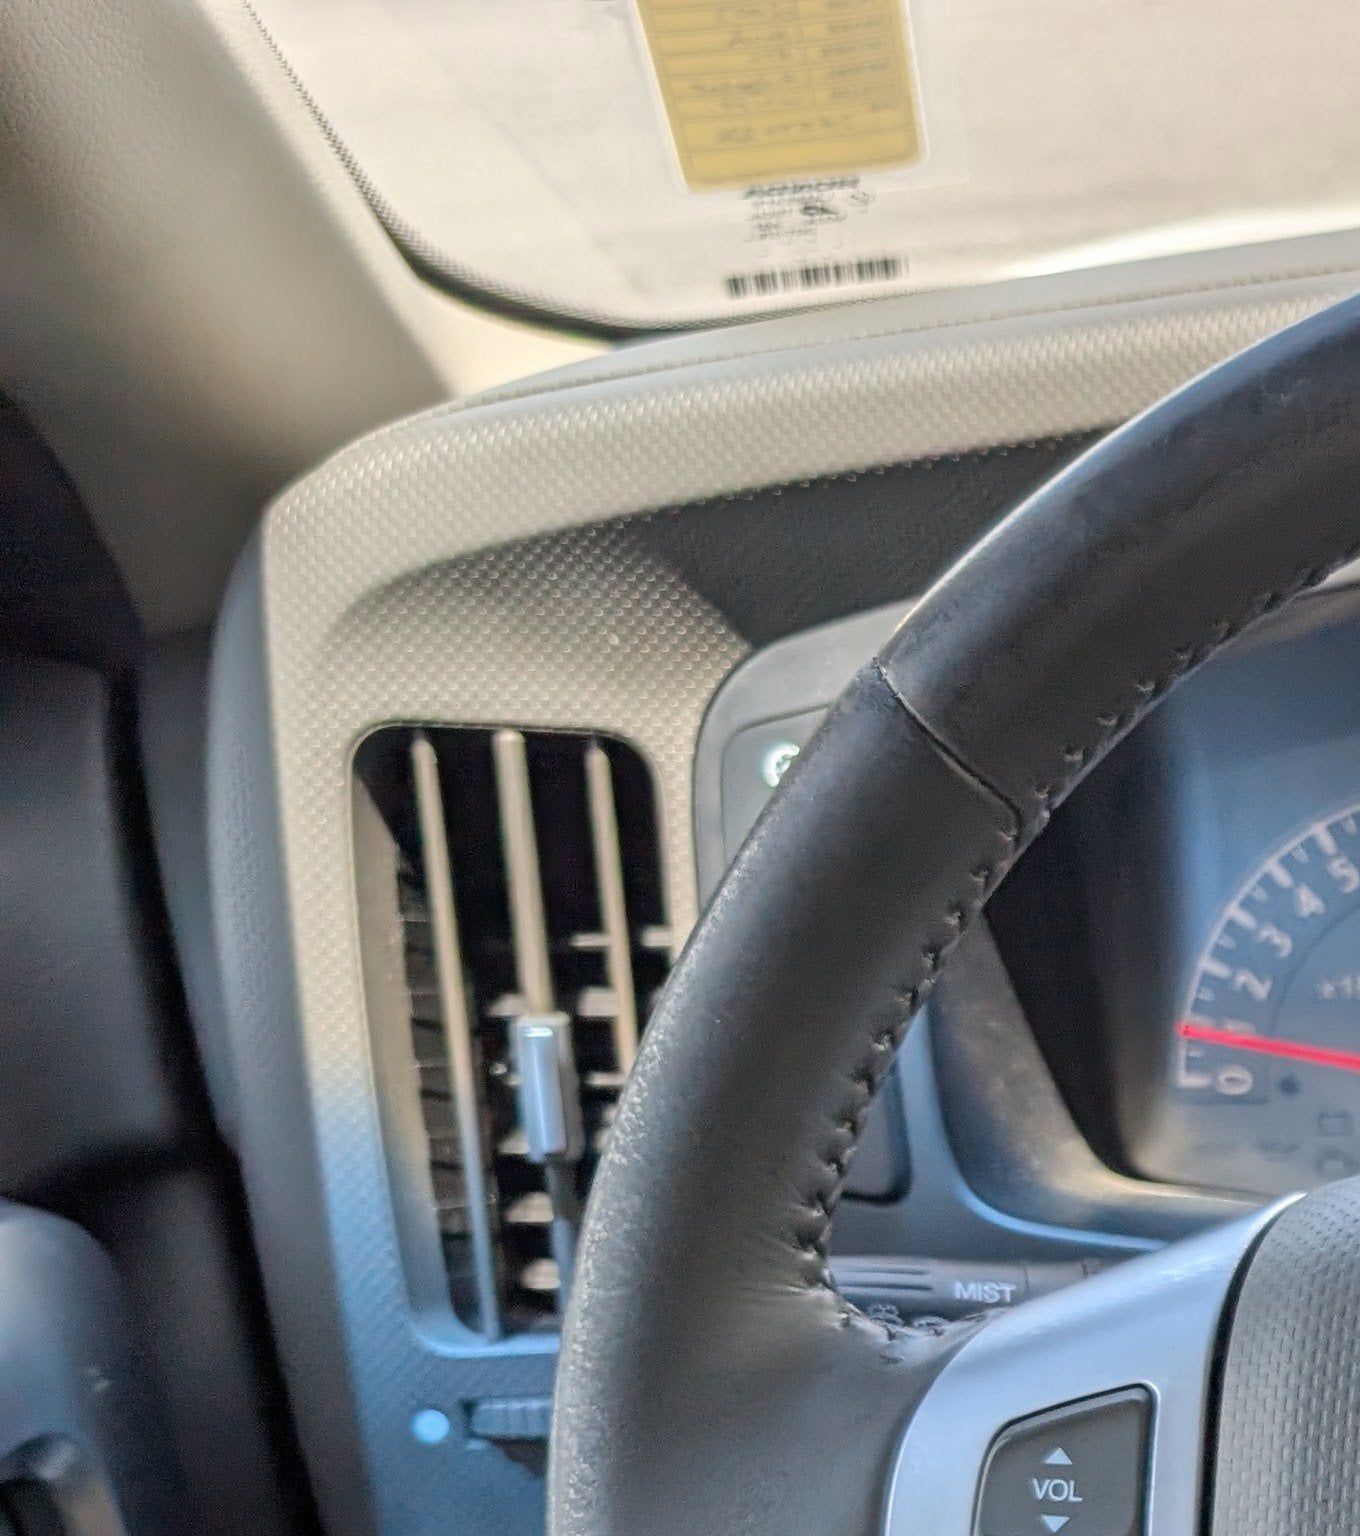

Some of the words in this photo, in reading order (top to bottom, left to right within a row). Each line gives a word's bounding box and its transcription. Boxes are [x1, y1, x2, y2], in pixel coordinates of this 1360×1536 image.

[1326, 855, 1360, 893] 5
[1259, 926, 1294, 957] 3
[1234, 970, 1272, 1000] 2
[1215, 1065, 1254, 1096] 0
[955, 1279, 1017, 1303] MIST
[1032, 1478, 1083, 1502] VOL
